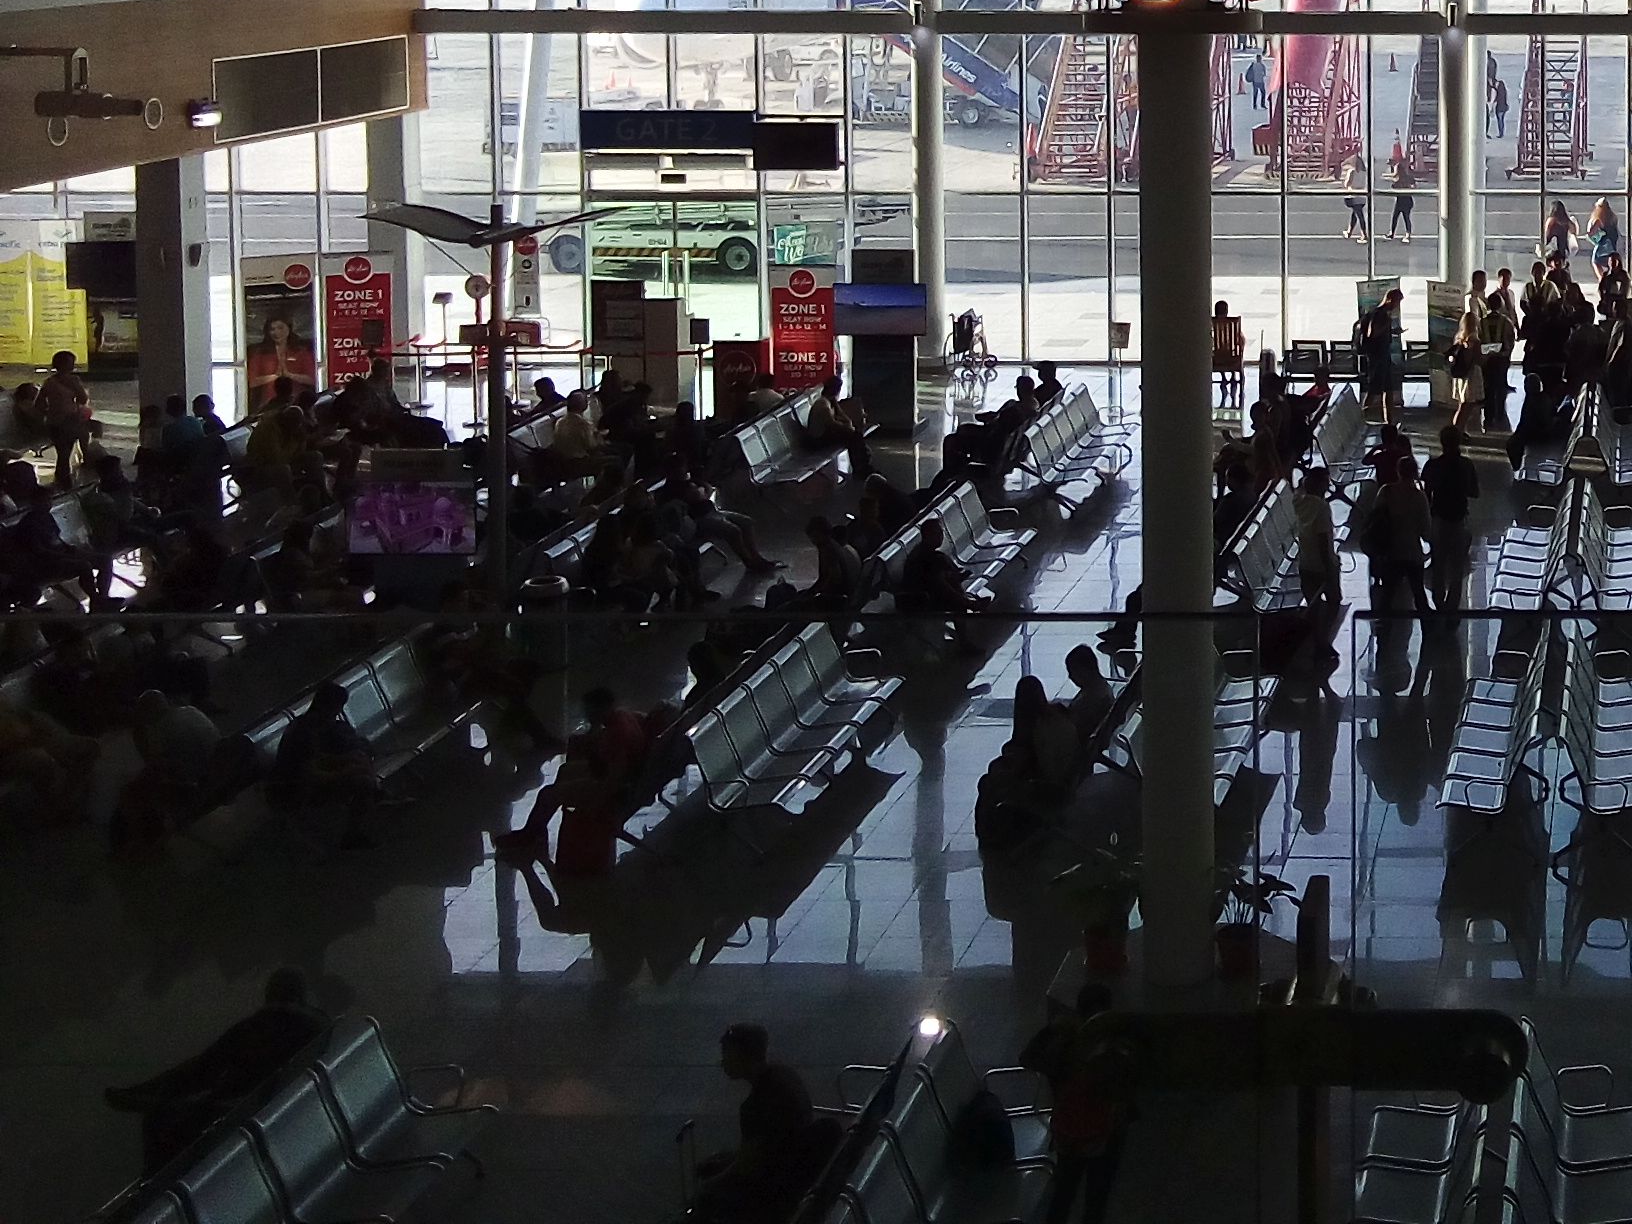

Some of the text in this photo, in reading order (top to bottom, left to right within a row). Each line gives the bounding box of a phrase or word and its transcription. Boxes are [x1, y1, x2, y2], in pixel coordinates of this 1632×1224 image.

[941, 52, 977, 84] Airlines
[616, 118, 718, 141] GATE 2
[334, 288, 383, 301] ZONE 1
[779, 304, 825, 315] ZONE 1
[333, 338, 362, 349] ZON
[779, 352, 828, 363] ZONE 2
